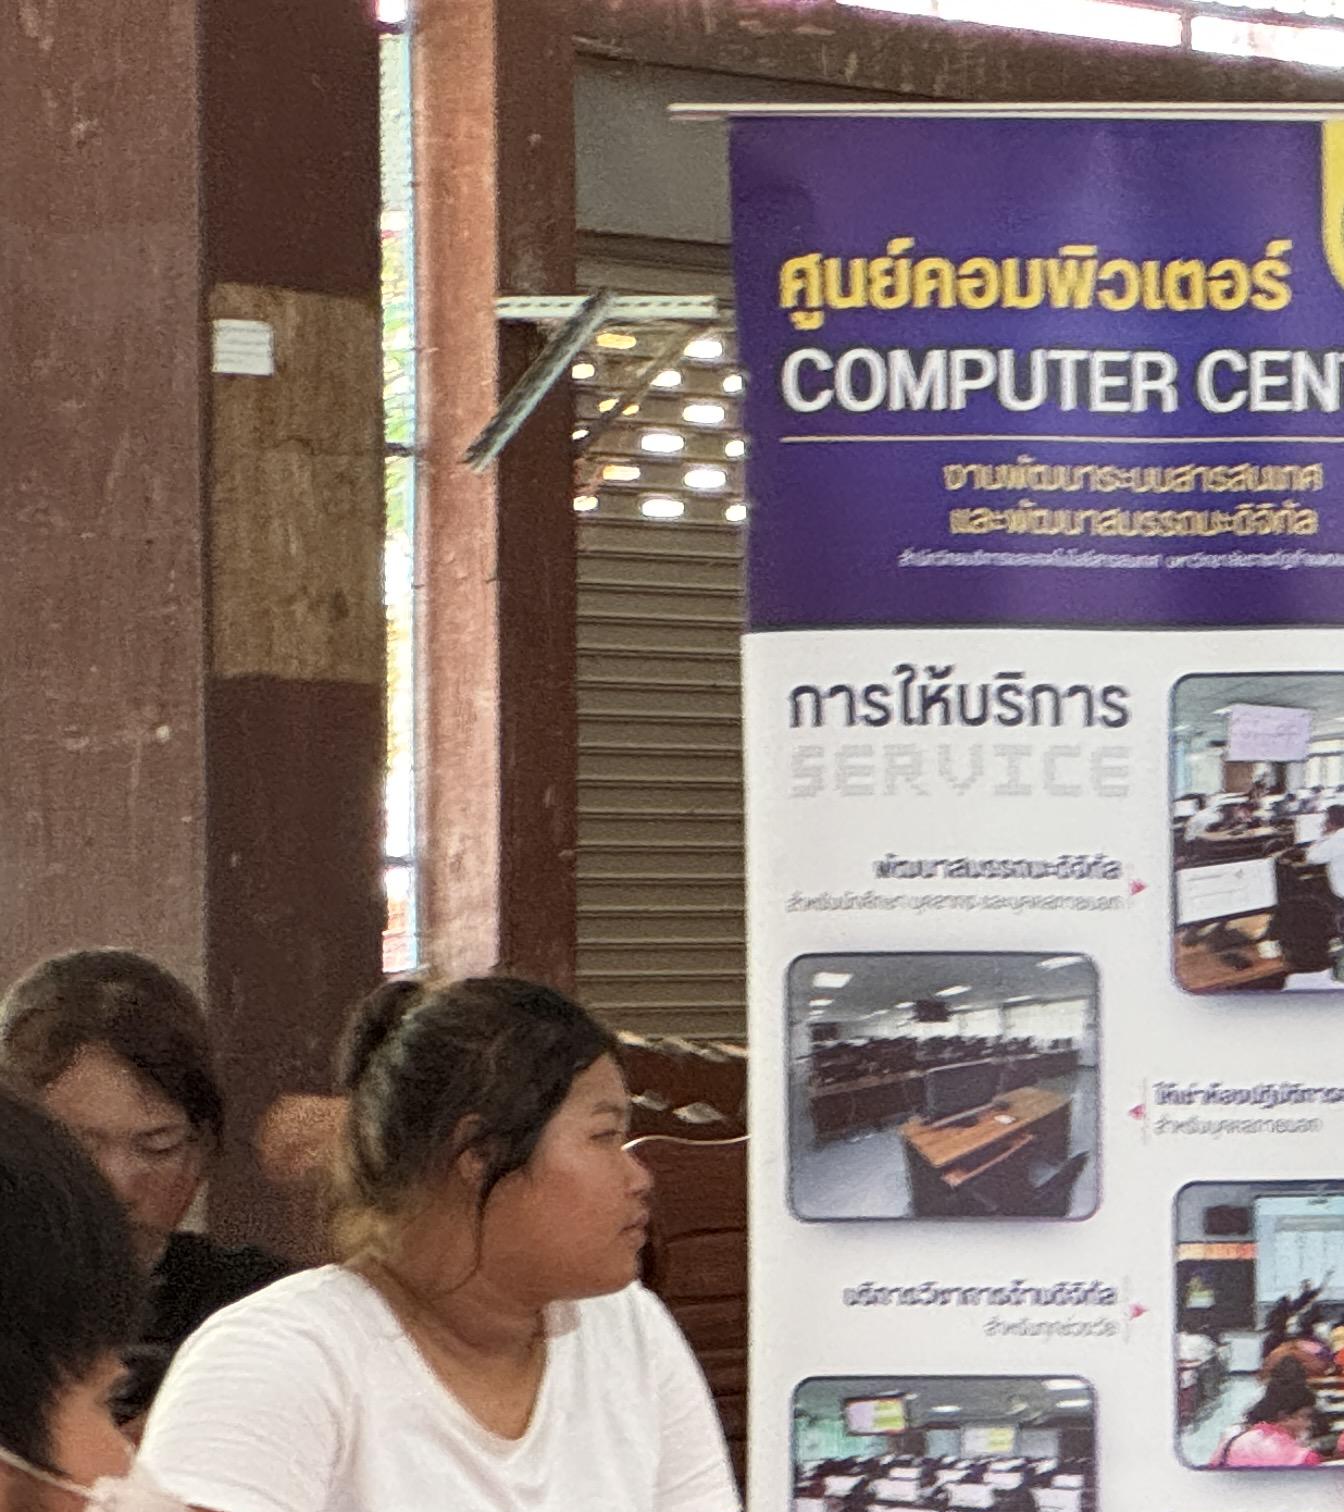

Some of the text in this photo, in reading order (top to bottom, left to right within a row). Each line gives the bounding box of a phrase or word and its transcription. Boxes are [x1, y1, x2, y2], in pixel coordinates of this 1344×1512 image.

[779, 237, 1293, 330] ศูนย์คอมพิวเตอร์
[781, 348, 1178, 413] COMPUTER
[789, 662, 1131, 729] การให้บริการ
[790, 742, 1132, 799] SERVICE
